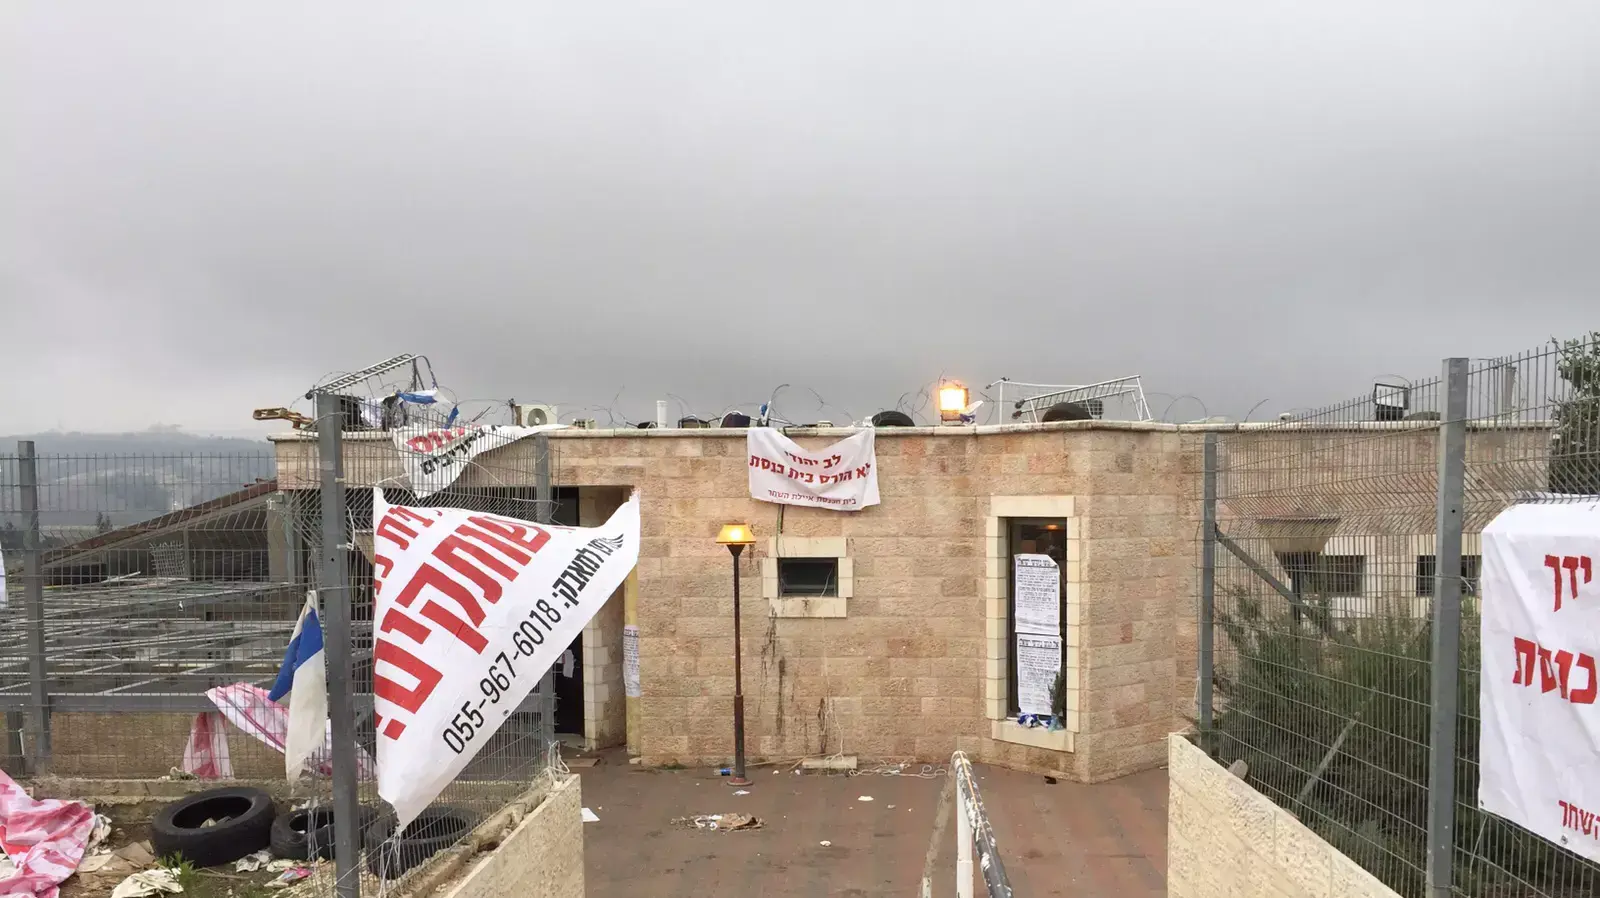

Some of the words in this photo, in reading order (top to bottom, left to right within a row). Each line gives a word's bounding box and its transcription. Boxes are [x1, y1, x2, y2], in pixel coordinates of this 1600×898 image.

[750, 455, 785, 475] כנסת
[784, 451, 819, 466] יהודי
[823, 454, 841, 469] לב
[788, 467, 814, 483] בית
[819, 470, 852, 484] הורס
[768, 489, 789, 499] השחר
[791, 493, 814, 502] איילת
[843, 496, 857, 505] בית
[552, 548, 605, 609] למאבק:
[442, 598, 562, 755] 055-967-6018
